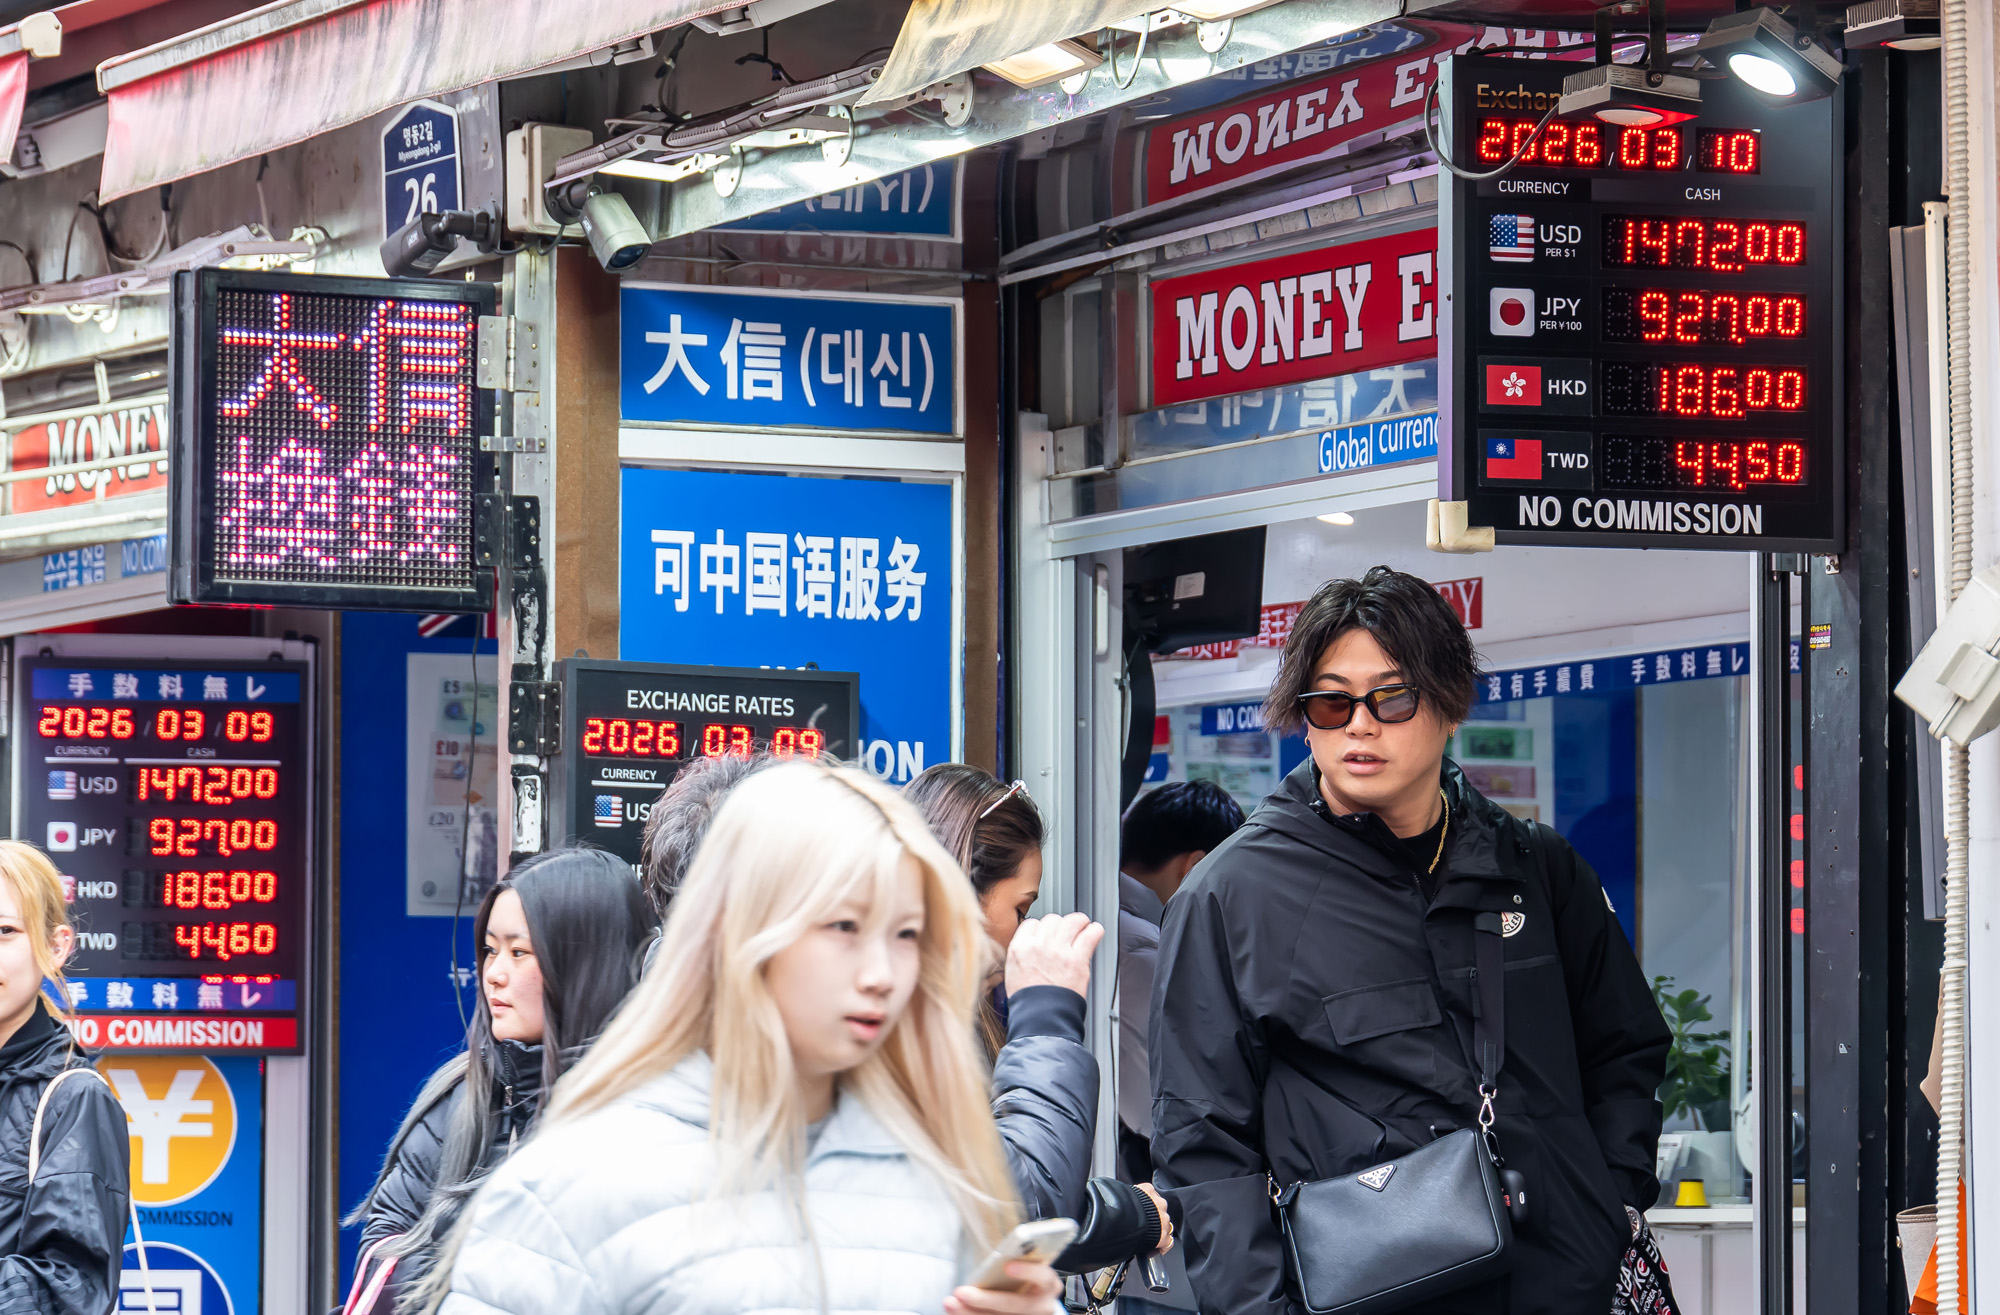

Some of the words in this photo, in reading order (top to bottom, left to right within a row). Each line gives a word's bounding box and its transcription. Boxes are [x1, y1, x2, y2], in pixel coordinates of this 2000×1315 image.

[402, 119, 433, 148] 명동2길
[1481, 121, 1599, 164] 2026
[1621, 127, 1678, 168] 03
[1714, 133, 1756, 172] 10
[405, 172, 438, 226] 26
[1498, 179, 1570, 195] CURRENCY
[1684, 187, 1722, 201] CASH
[1540, 224, 1582, 244] USD
[1625, 221, 1801, 273] 1472.00
[1545, 248, 1562, 257] PER
[1176, 262, 1373, 381] MONEY
[1540, 297, 1582, 317] JPY
[1641, 292, 1801, 344] 927.00
[1540, 320, 1558, 330] PER
[1559, 321, 1582, 331] ¥100
[223, 293, 472, 436] 大信
[1547, 379, 1587, 397] HKD
[1660, 367, 1801, 417] 186.00
[46, 404, 168, 496] MONEY
[1320, 423, 1373, 472] Global
[1547, 452, 1589, 469] TWD
[1518, 495, 1562, 527] NO
[1572, 497, 1762, 535] COMMISSION
[651, 528, 927, 622] 可中国语服务
[626, 689, 730, 714] EXCHANGE
[735, 695, 795, 717] RATES
[1216, 707, 1234, 731] NO
[38, 706, 135, 740] 2026
[156, 709, 205, 741] 03
[225, 710, 274, 742] 09
[583, 717, 679, 756] 2026
[703, 724, 751, 760] 03
[774, 728, 821, 760] 09
[54, 746, 111, 757] CURRENCY
[186, 748, 216, 758] CASH
[79, 776, 118, 794] USD
[138, 767, 278, 805] 1472.00
[601, 767, 657, 781] CURRENCY
[626, 802, 656, 822] US
[79, 828, 117, 846] JPY
[150, 818, 278, 858] 927.00
[77, 881, 118, 899] HKD
[163, 871, 278, 910] 186.00
[77, 932, 118, 950] TWD
[107, 1019, 264, 1046] COMMISSION
[129, 1209, 233, 1228] OMMISSION
